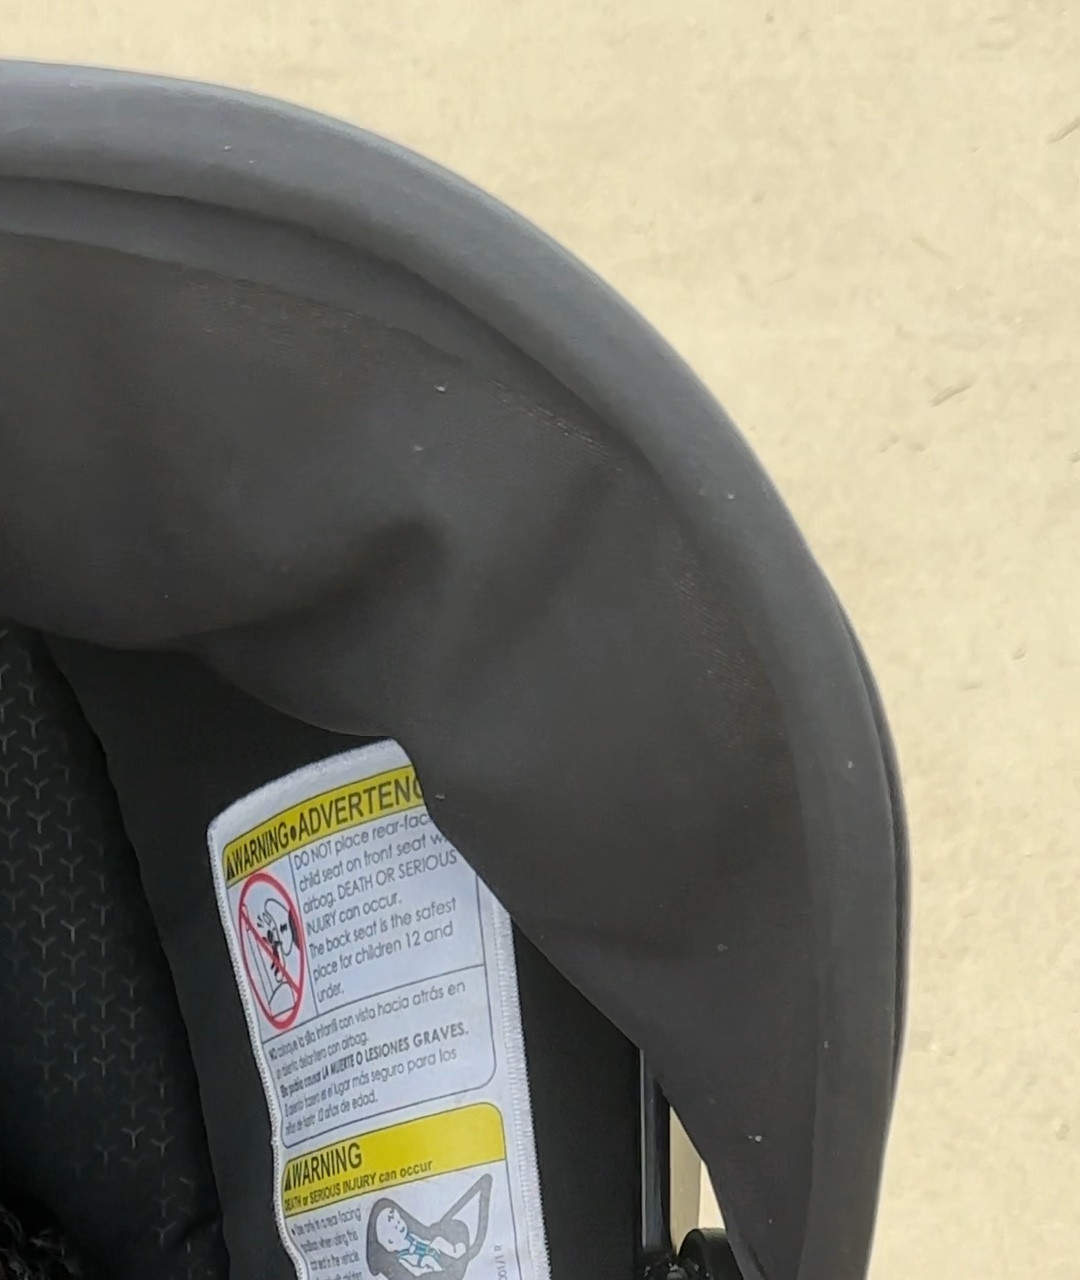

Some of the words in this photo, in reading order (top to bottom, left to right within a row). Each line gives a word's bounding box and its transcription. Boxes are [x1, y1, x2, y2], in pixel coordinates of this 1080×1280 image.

[233, 821, 289, 875] WARNING
[293, 851, 309, 871] DO
[312, 840, 333, 862] NOT
[335, 831, 369, 855] place
[299, 871, 321, 893] child
[322, 860, 344, 883] seat
[346, 857, 361, 873] on
[364, 844, 393, 867] front
[396, 833, 426, 857] seat
[337, 876, 373, 900] DEATH
[375, 867, 396, 886] OR
[398, 850, 458, 880] SERIOUS
[325, 929, 351, 952] back
[353, 921, 377, 942] seat
[390, 912, 412, 929] the
[416, 897, 457, 922] safest
[339, 906, 361, 923] can
[362, 892, 402, 915] occur.
[355, 939, 402, 965] children
[406, 930, 421, 948] 12
[424, 920, 454, 942] and
[377, 995, 410, 1016] hacia
[412, 986, 444, 1006] atrás
[447, 982, 467, 996] en
[364, 1037, 410, 1063] LESIONES
[412, 1021, 469, 1048] GRAVES.
[370, 1062, 405, 1083] seguro
[407, 1054, 437, 1074] para
[439, 1047, 457, 1063] los
[292, 1142, 362, 1189] WARNING
[342, 1172, 377, 1194] INJURY
[379, 1170, 397, 1183] can
[399, 1160, 433, 1177] occur
